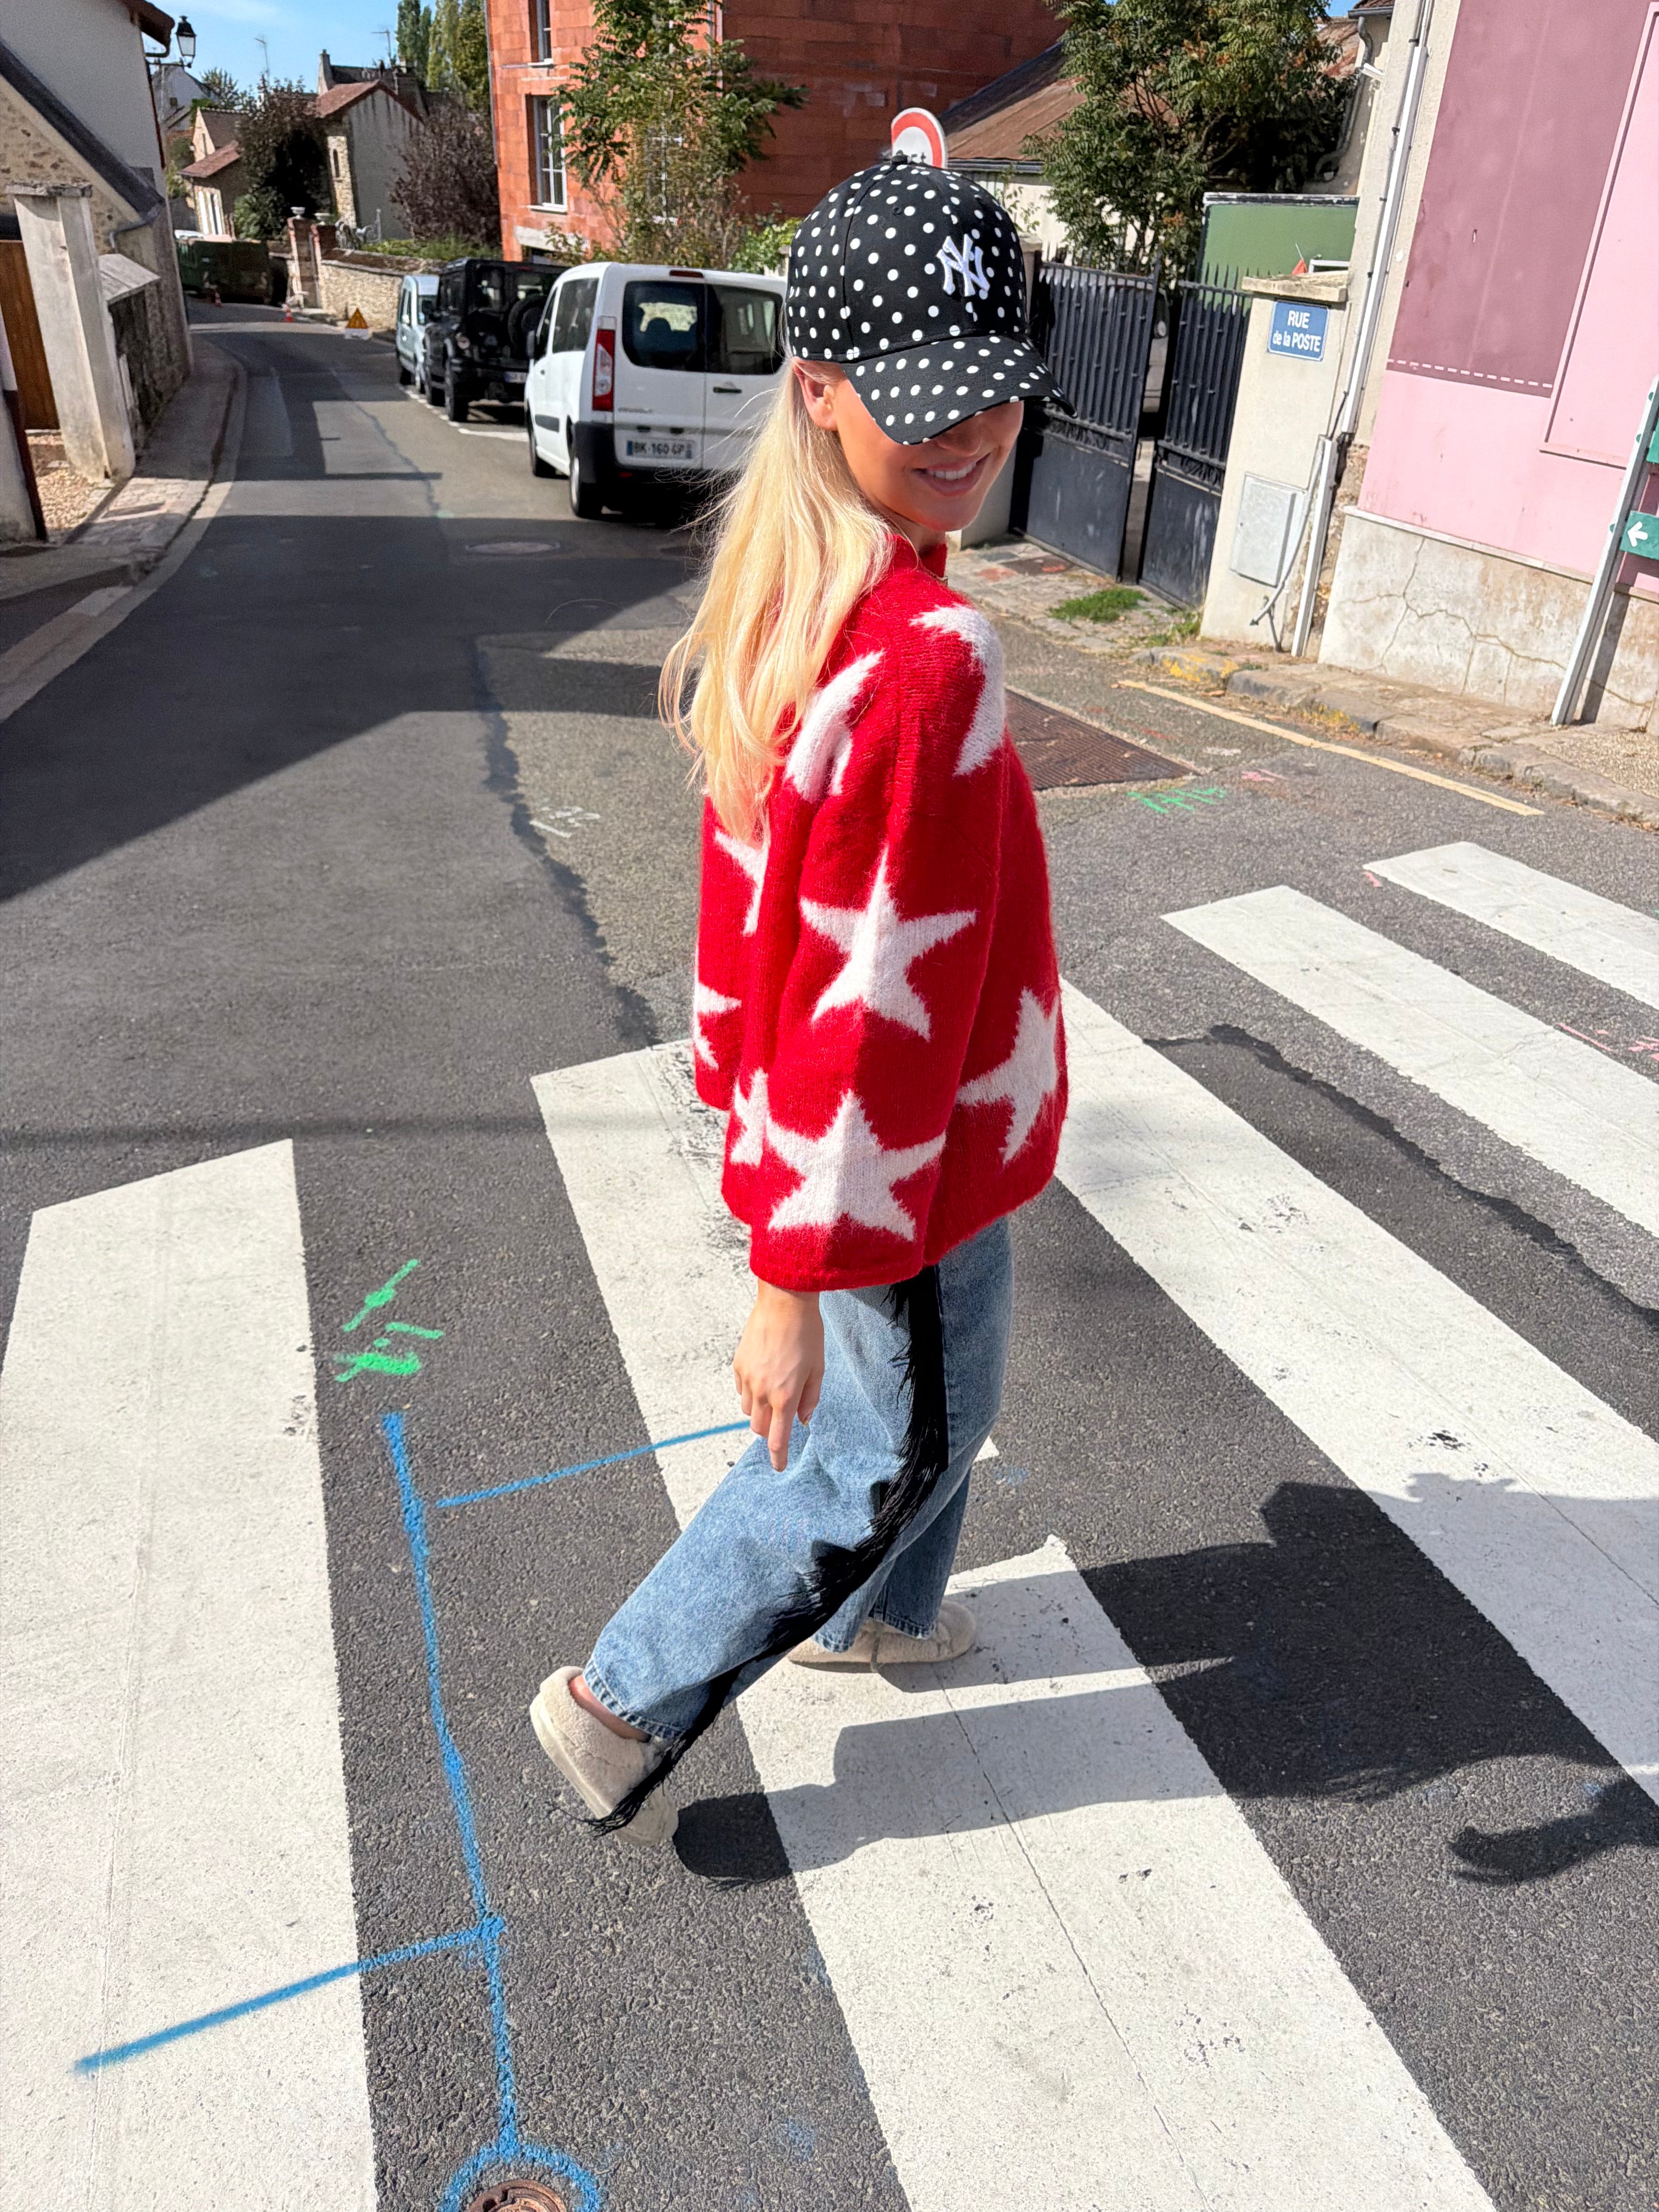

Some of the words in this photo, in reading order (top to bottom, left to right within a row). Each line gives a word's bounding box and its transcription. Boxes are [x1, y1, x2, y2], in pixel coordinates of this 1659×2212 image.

[936, 234, 990, 297] NY
[1287, 310, 1310, 329] RUE
[1273, 330, 1282, 345] de
[1283, 331, 1291, 347] la
[1291, 332, 1322, 352] POSTE
